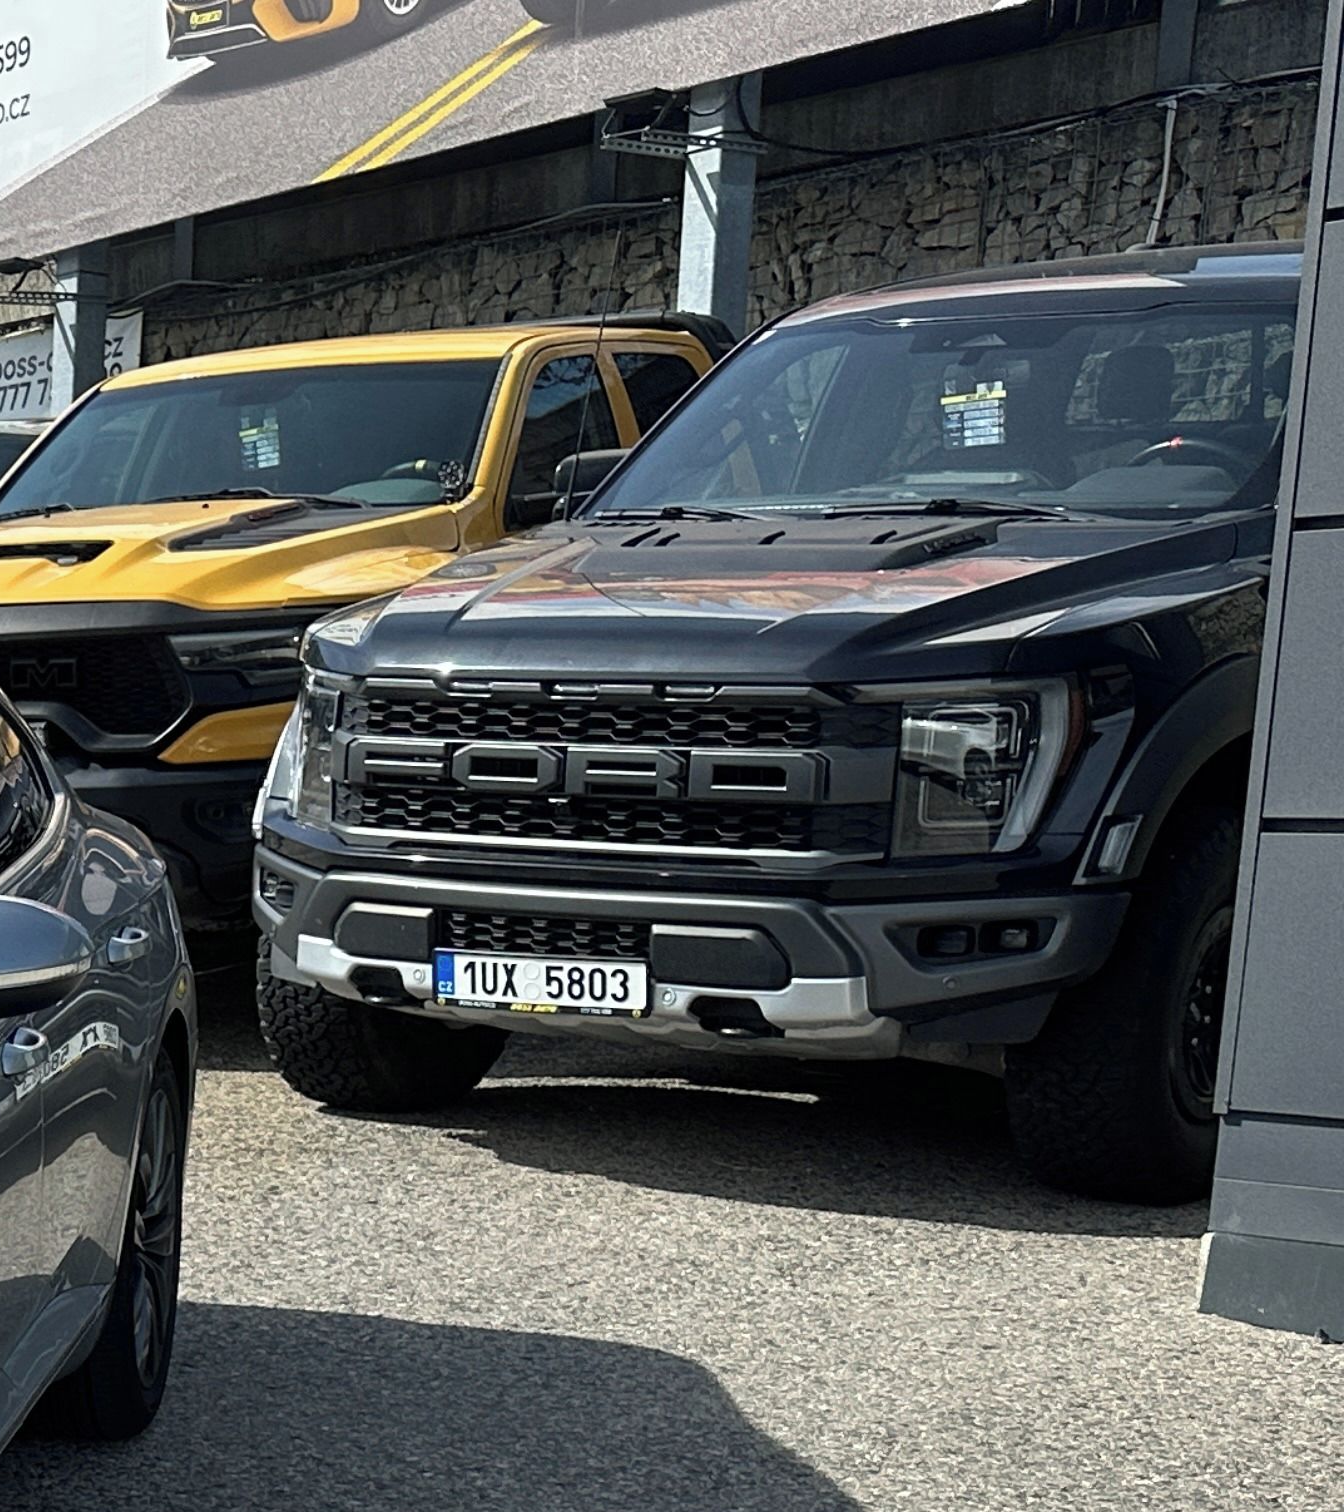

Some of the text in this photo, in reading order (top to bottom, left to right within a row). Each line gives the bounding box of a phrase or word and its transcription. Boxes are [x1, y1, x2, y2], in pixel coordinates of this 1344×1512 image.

[342, 738, 826, 801] FORD
[438, 961, 629, 1002] CZ 1UX 5803
